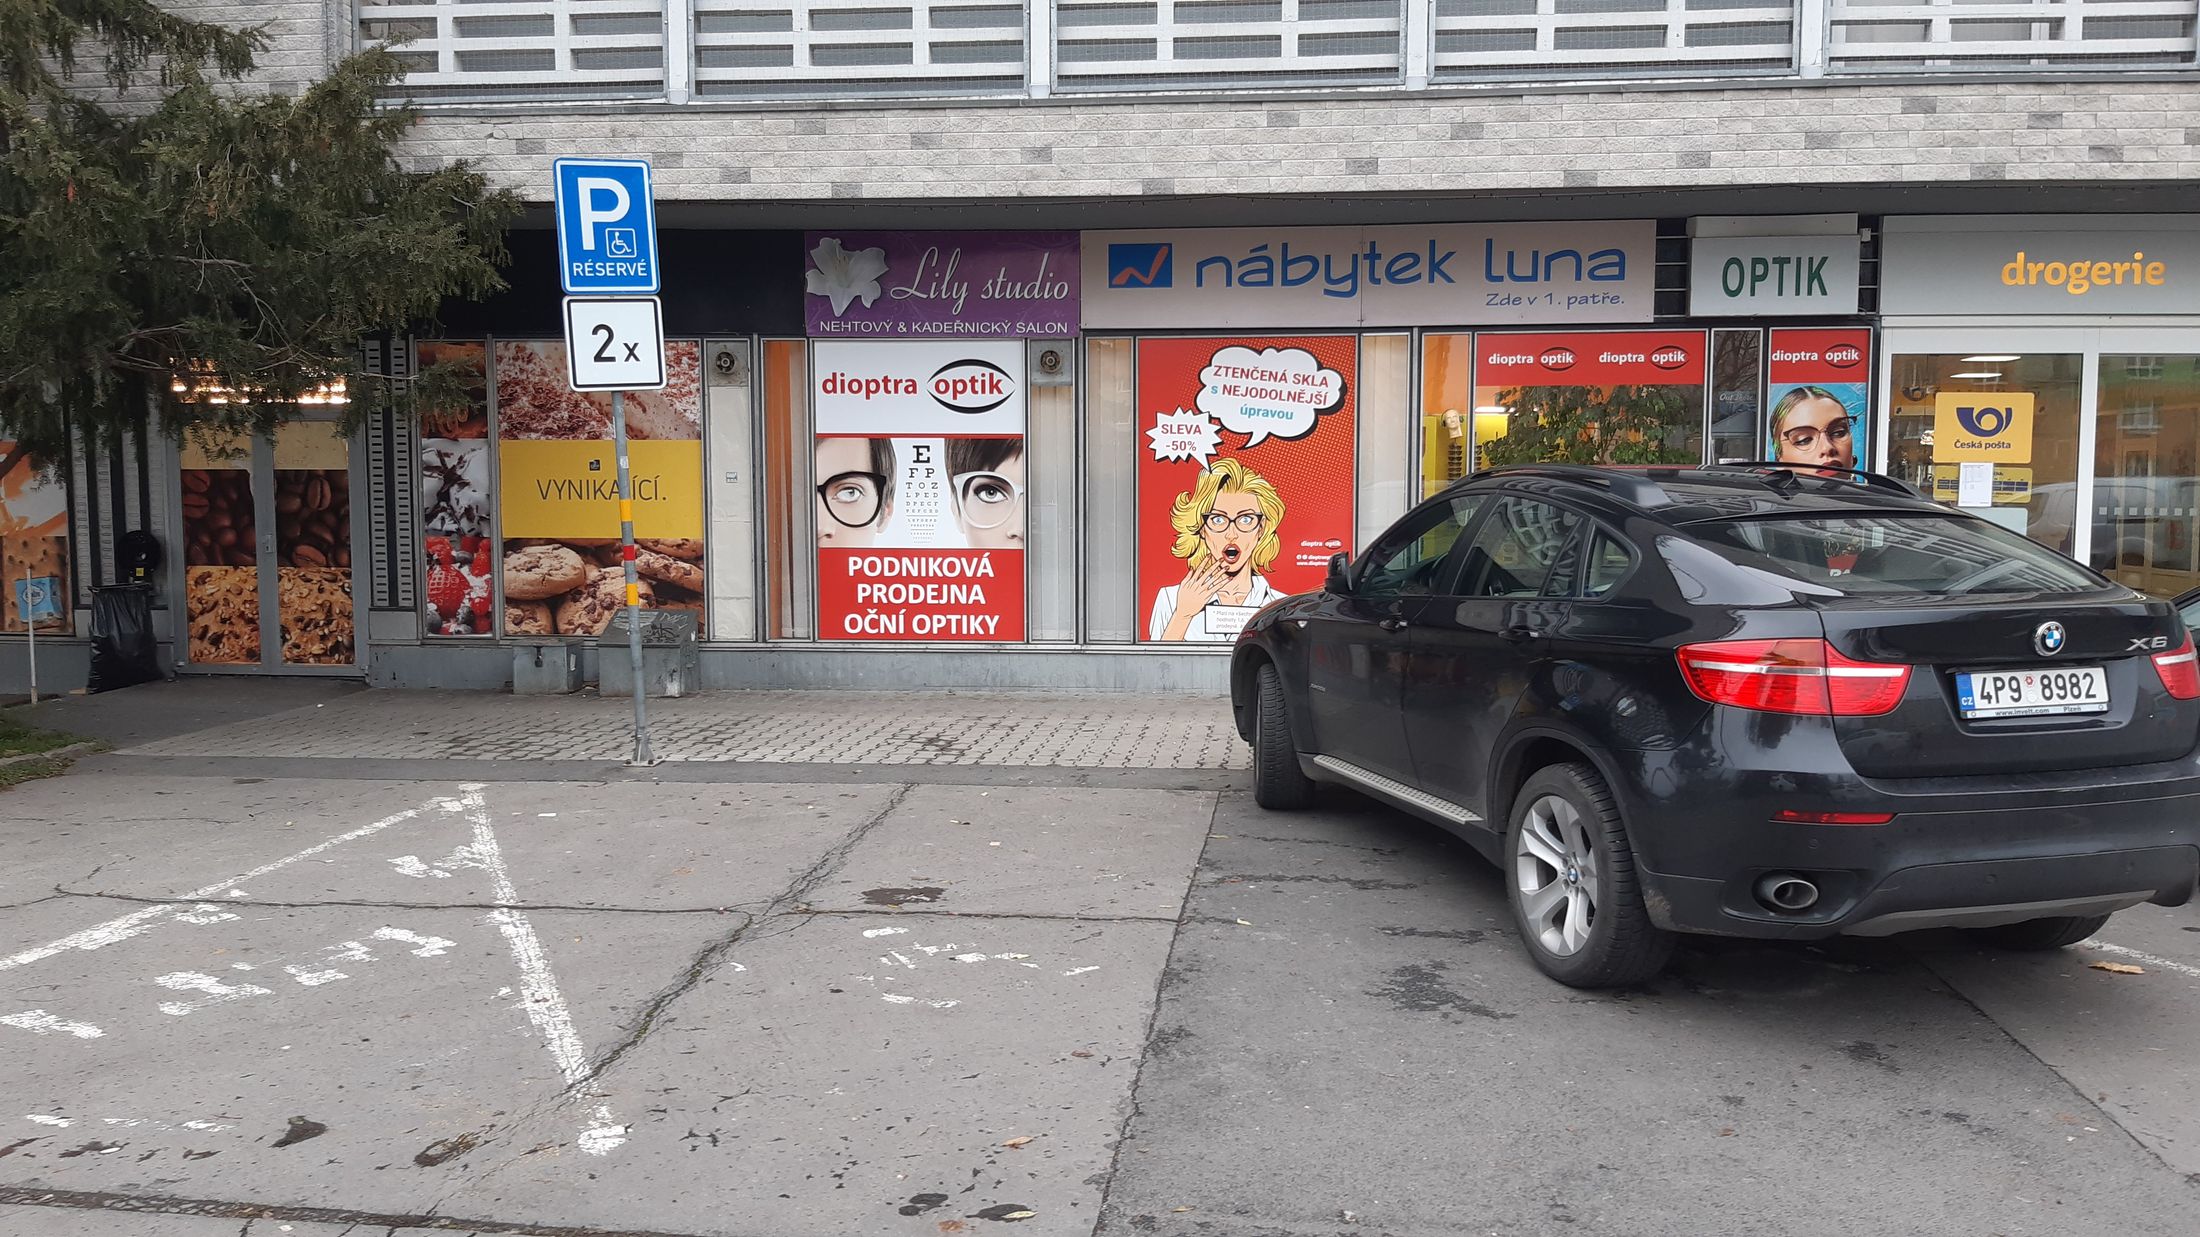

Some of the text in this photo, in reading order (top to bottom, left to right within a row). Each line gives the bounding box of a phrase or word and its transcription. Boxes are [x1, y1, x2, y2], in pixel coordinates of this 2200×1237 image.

[577, 177, 630, 250] P
[573, 259, 647, 277] RÉSERVÉ
[1196, 239, 1627, 299] nábytek luna
[1721, 255, 1829, 298] OPTIK
[2001, 251, 2166, 295] drogerie
[890, 246, 1070, 315] Lily studio
[1486, 290, 1626, 310] Zde v 1. patře.
[820, 320, 1068, 334] NEHTOVÝ & KADEŘNICKÝ SALON
[1488, 350, 1574, 367] dioptra optik
[1599, 349, 1686, 366] dioptra optik
[1772, 349, 1859, 363] dioptra optik
[822, 372, 1004, 400] dioptra optik
[1213, 365, 1329, 388] ZTENČENÁ SKLA
[1211, 384, 1329, 406] s NEJODOLNĚJŠÍ
[1240, 404, 1294, 420] úpravou
[1161, 424, 1202, 435] SLEVA
[912, 445, 930, 463] E
[1165, 440, 1197, 451] -50%
[1954, 439, 2011, 450] Česká pošta
[536, 475, 668, 501] VYNIKAÍCÍ.
[848, 552, 994, 577] PODNIKOVÁ
[857, 584, 986, 604] PRODEJNA
[844, 608, 1000, 635] OČNÍ OPTIKY
[2126, 636, 2168, 651] X6
[1980, 672, 2097, 704] 4P9 8982
[1961, 697, 1974, 706] CZ
